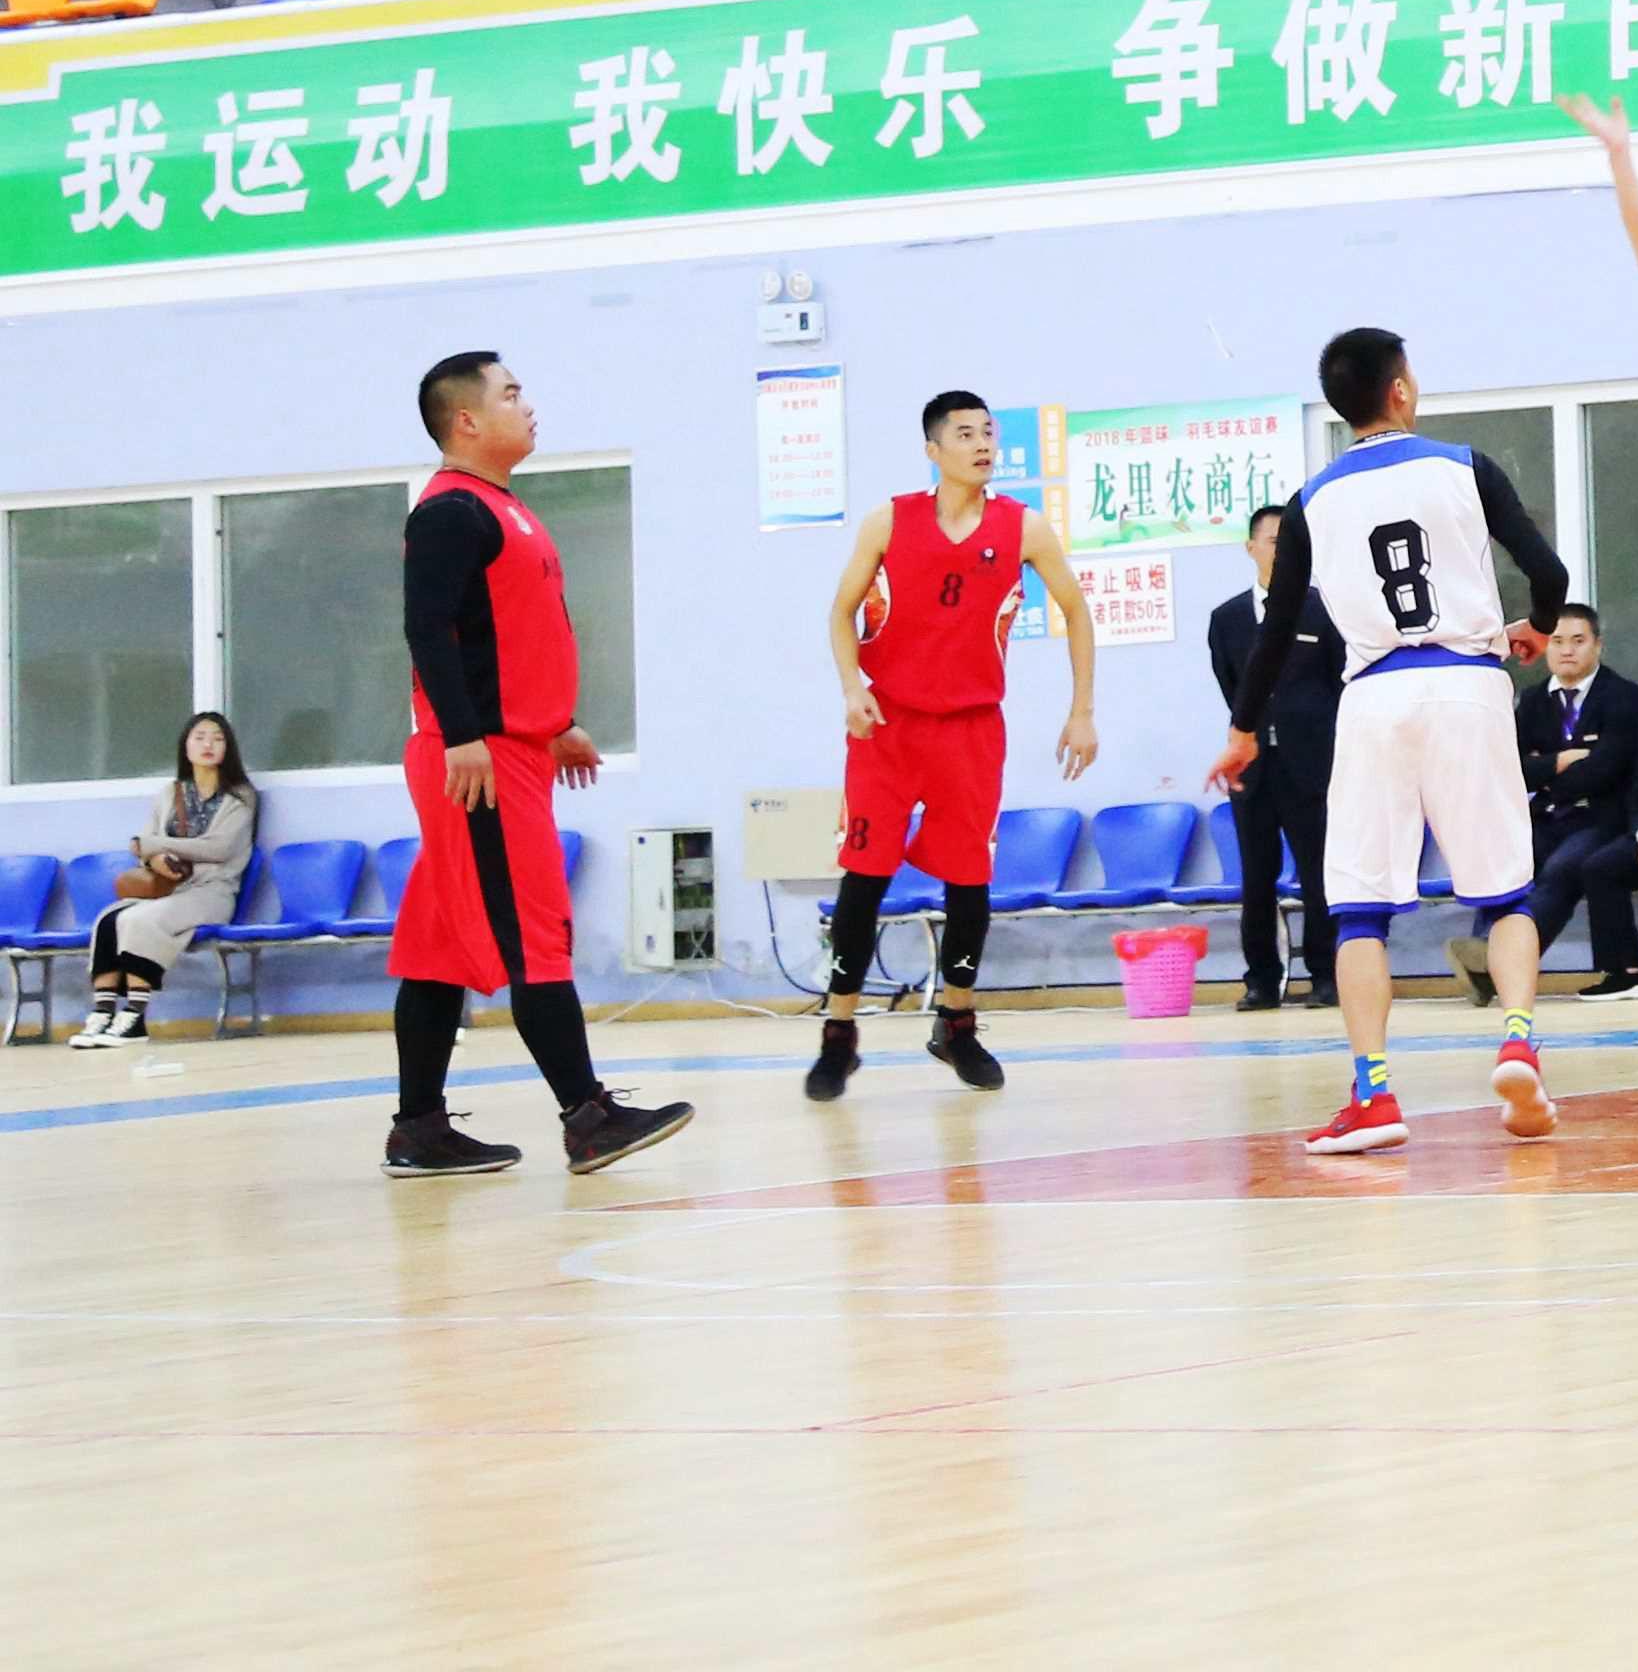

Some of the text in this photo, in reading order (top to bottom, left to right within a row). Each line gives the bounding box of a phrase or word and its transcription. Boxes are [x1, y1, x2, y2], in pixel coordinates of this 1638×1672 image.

[61, 67, 453, 234] 我运动
[568, 14, 986, 187] 我快乐
[1086, 450, 1275, 522] 龙里农商行
[939, 571, 964, 608] 8
[1079, 564, 1166, 596] 禁止吸烟
[1368, 518, 1440, 636] 8
[1094, 598, 1168, 624] 者罚款50元
[850, 816, 870, 851] 8
